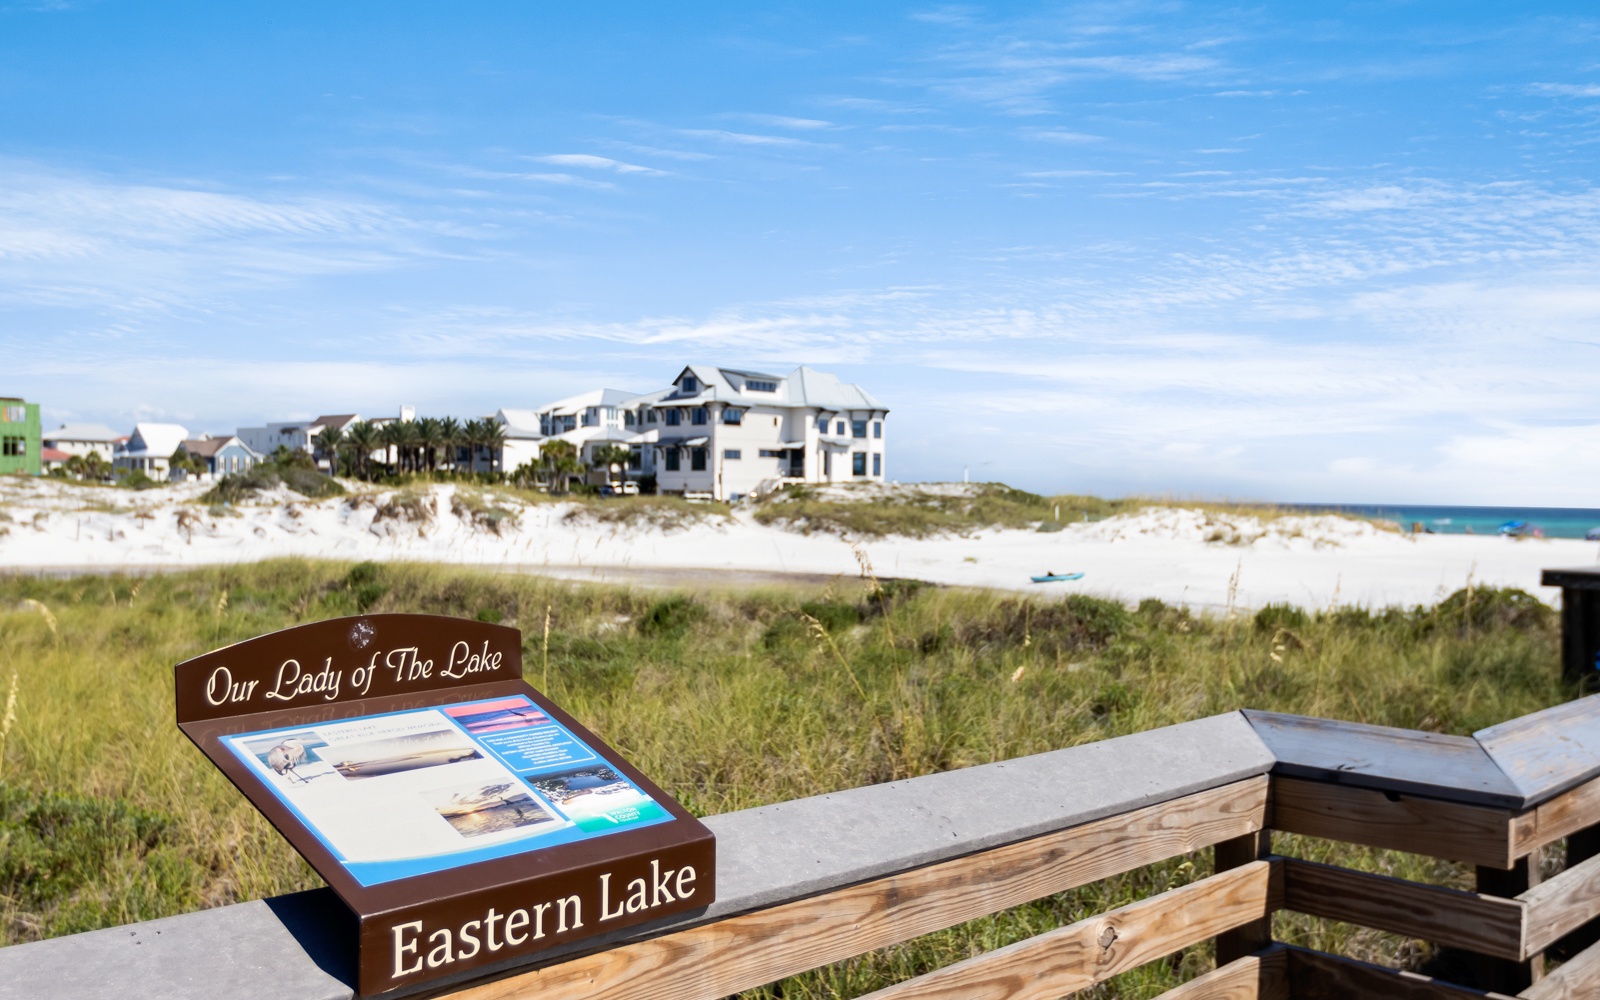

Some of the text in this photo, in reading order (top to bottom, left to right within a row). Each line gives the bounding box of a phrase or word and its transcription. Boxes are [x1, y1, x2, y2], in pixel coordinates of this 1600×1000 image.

[206, 640, 502, 706] Our Lady of The Lake
[391, 859, 697, 979] Eastern Lake
